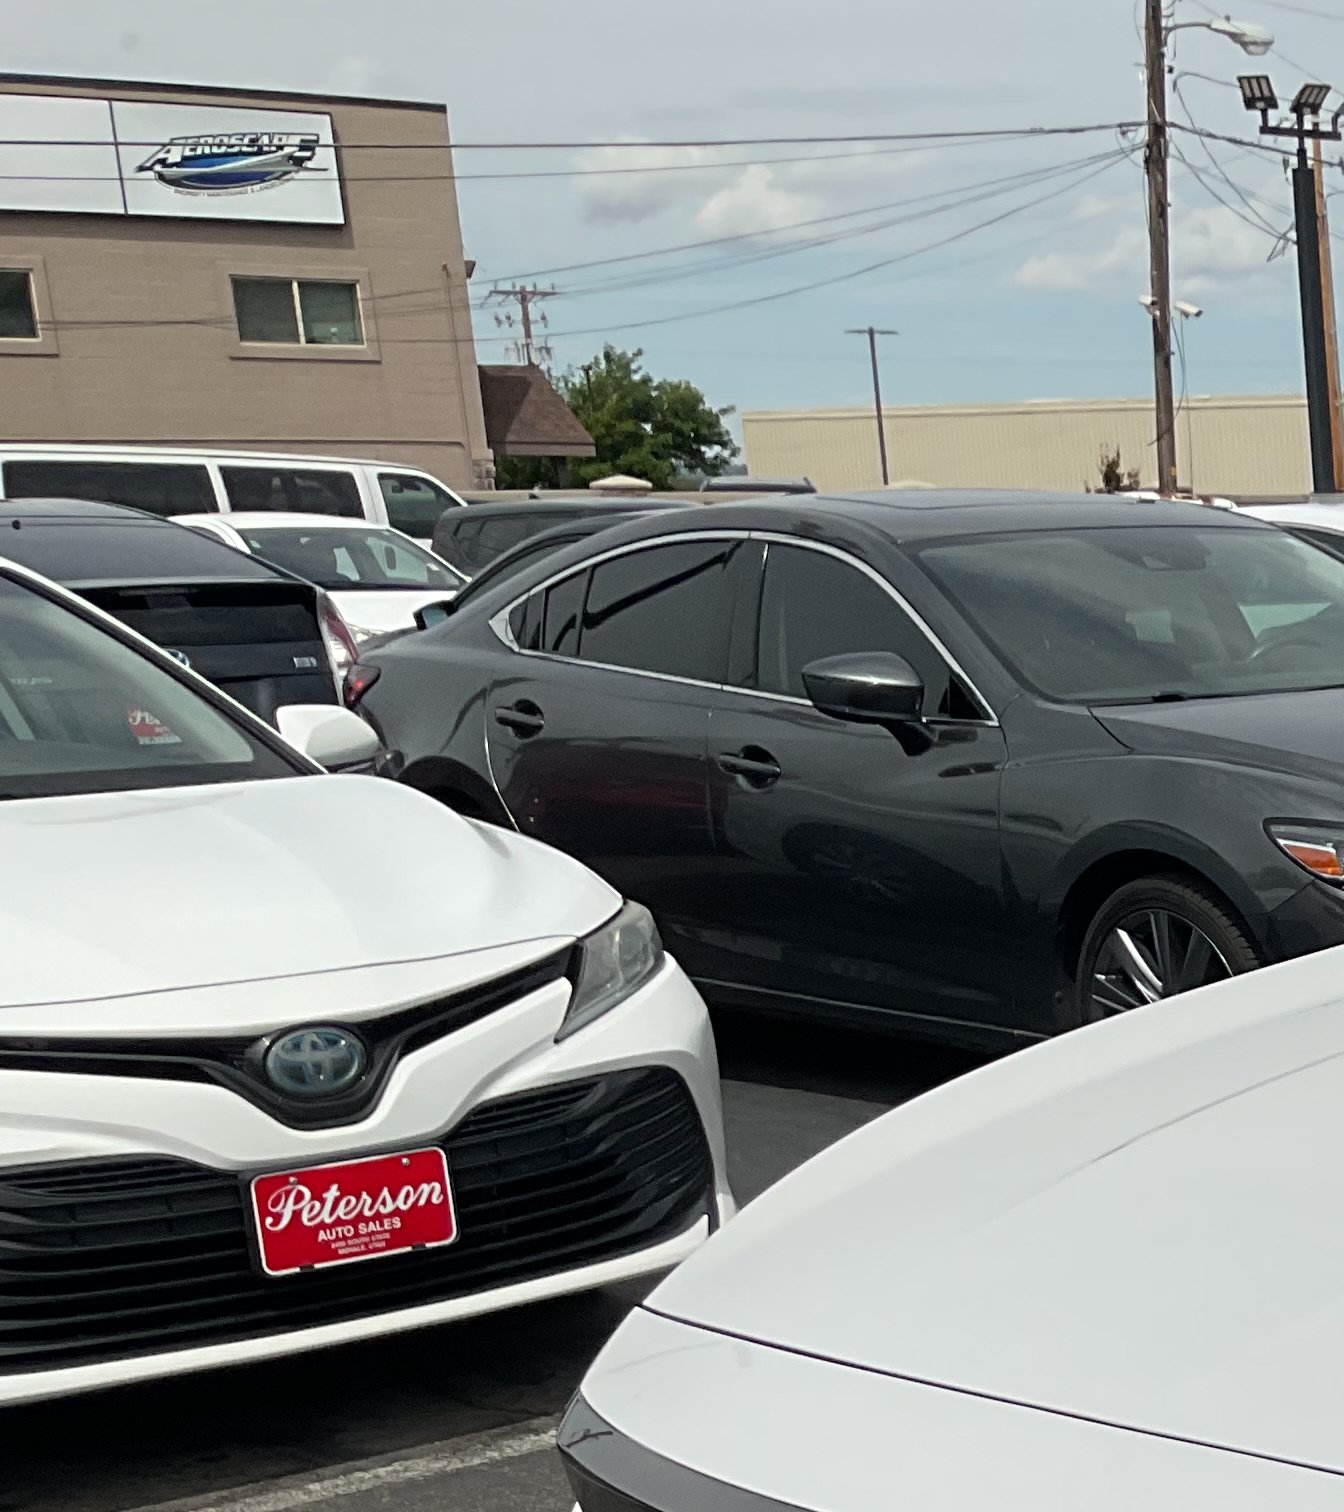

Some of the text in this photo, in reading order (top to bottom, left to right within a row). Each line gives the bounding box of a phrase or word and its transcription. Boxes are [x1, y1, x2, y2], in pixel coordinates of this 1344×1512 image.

[136, 133, 320, 172] AEROSCAPE
[265, 1181, 444, 1231] Peterson
[318, 1225, 355, 1242] AUTO
[358, 1216, 402, 1235] SALES
